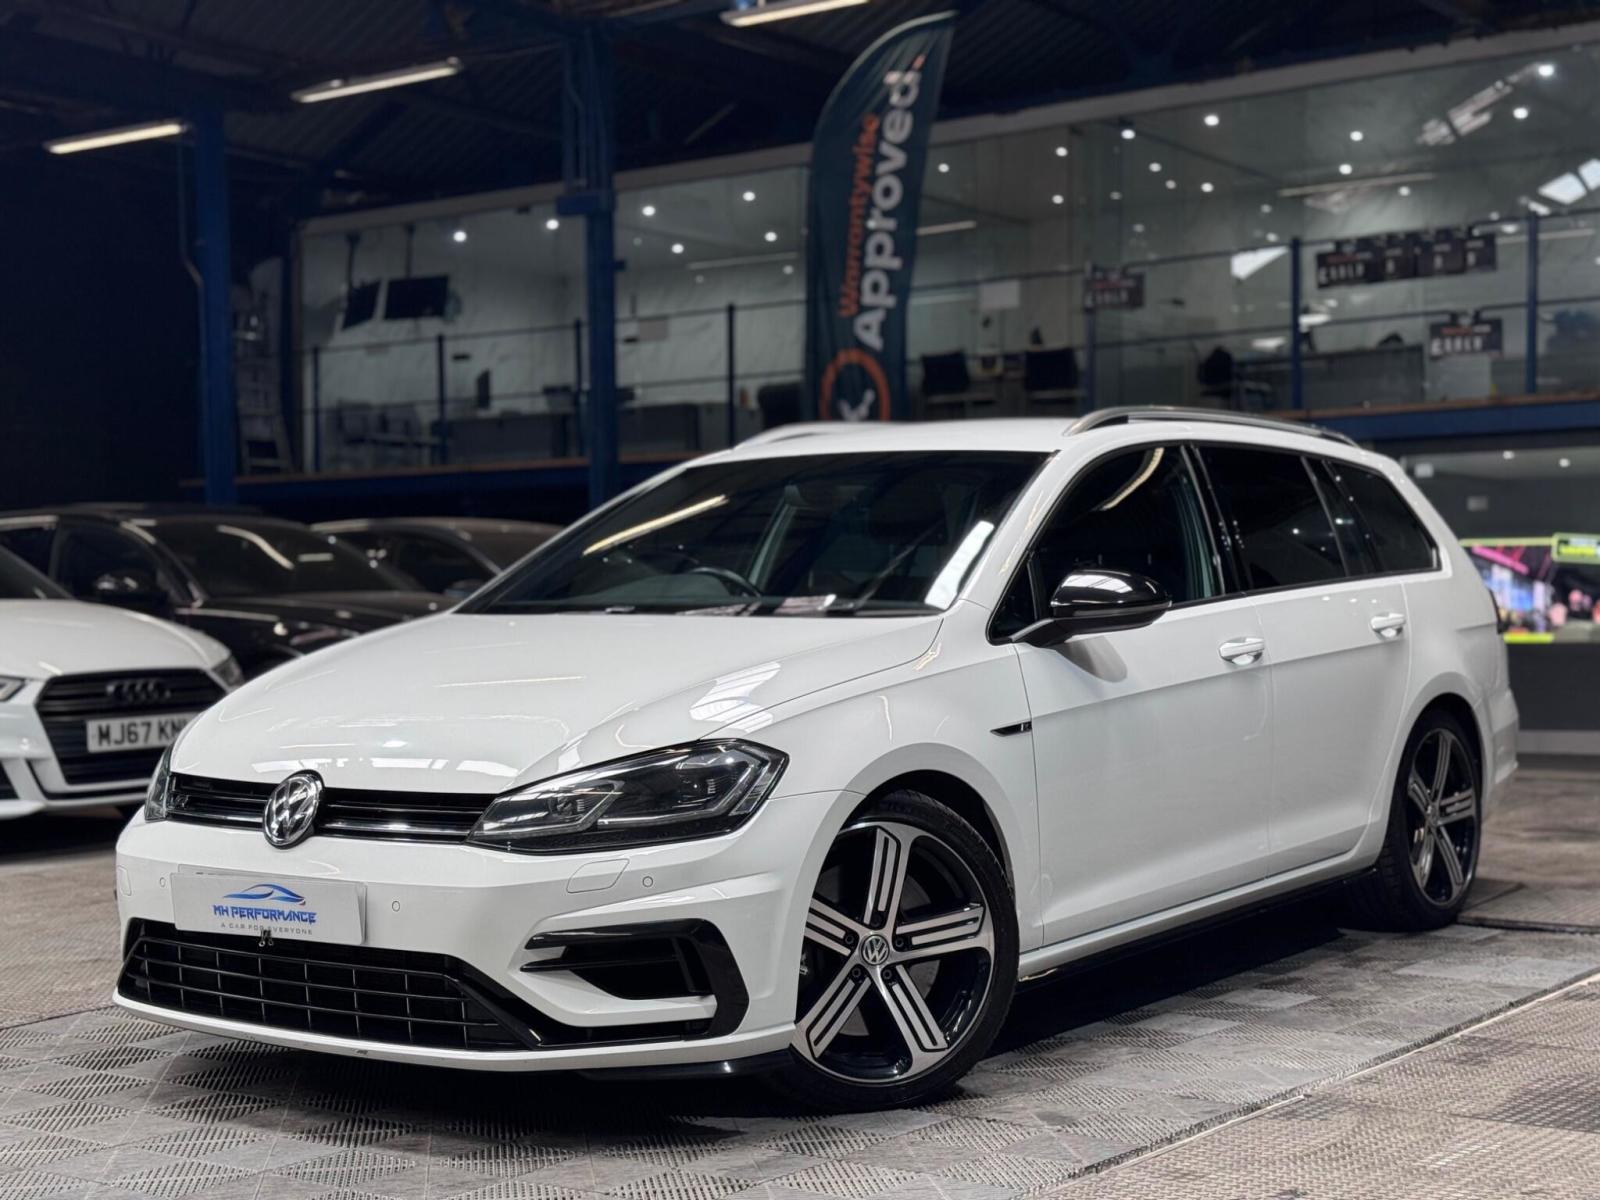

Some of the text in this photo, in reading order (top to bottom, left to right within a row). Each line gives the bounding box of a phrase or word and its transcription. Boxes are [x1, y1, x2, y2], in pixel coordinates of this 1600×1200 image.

[98, 718, 188, 747] MJ67 KN
[231, 906, 317, 924] PERFORMANCE
